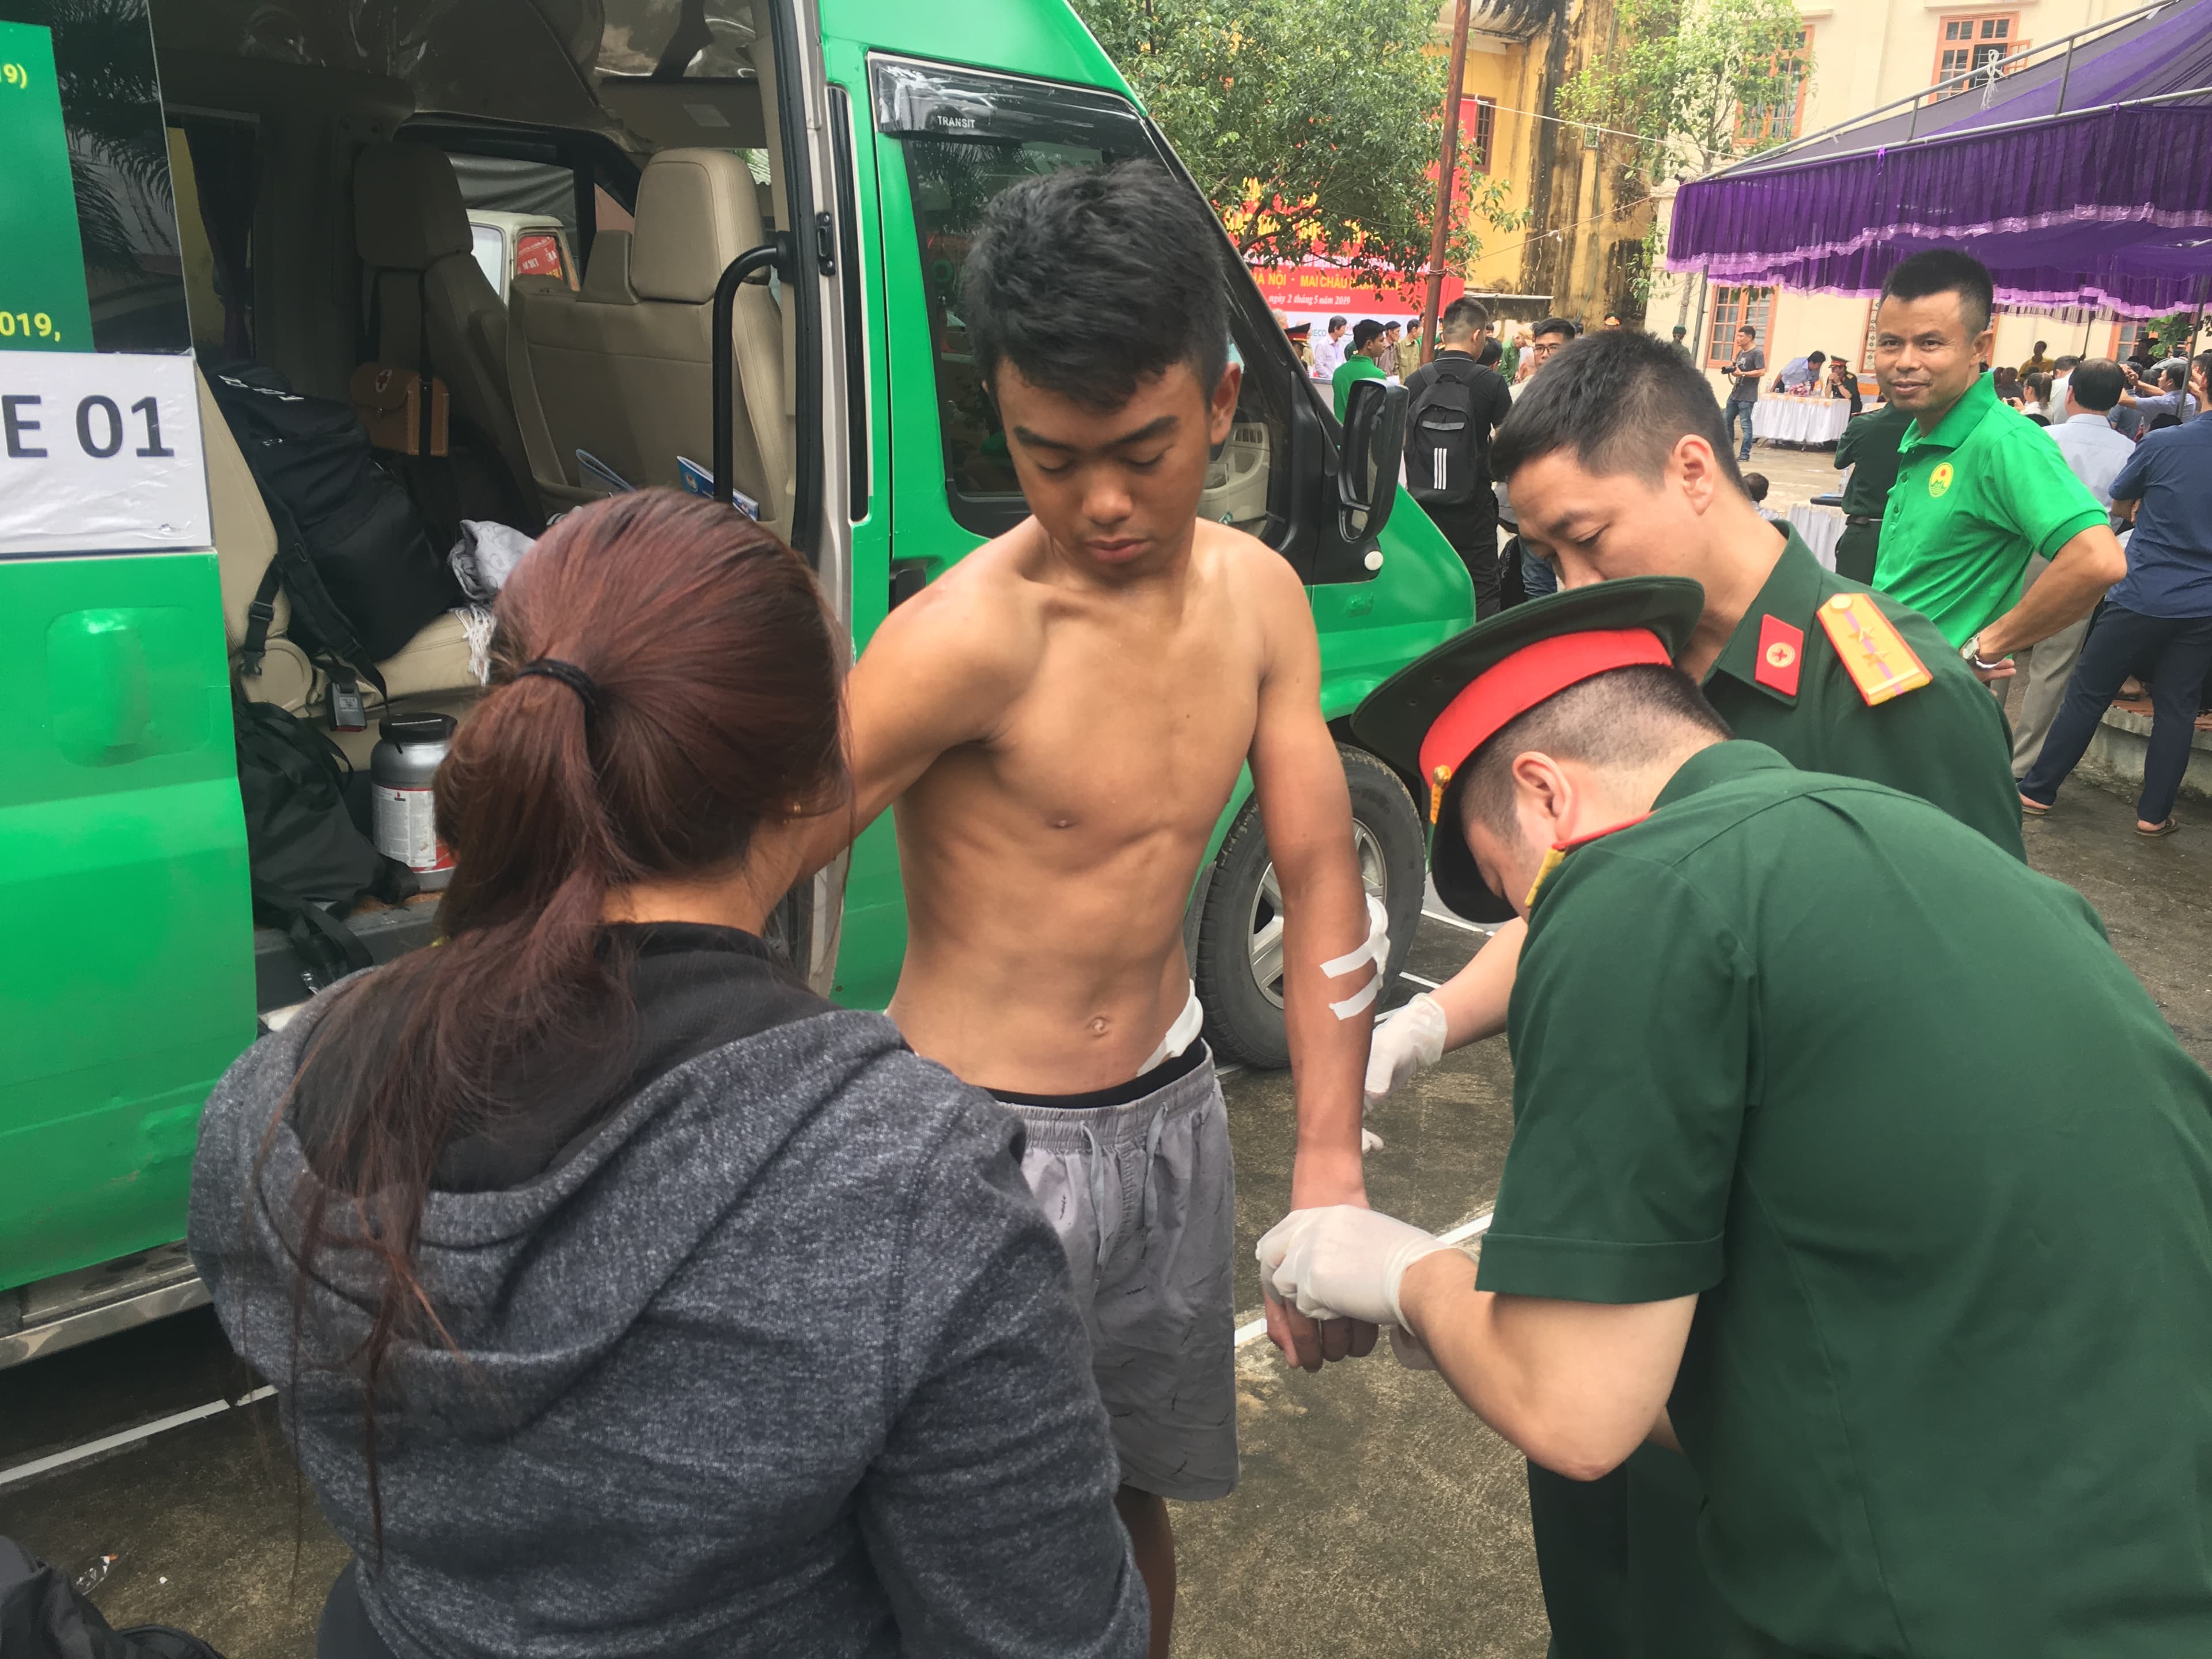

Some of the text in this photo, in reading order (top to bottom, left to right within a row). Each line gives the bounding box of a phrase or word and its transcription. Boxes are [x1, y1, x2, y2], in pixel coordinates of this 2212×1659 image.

[0, 63, 27, 89] 9)
[937, 115, 976, 129] TRANSIT
[1268, 269, 1286, 289] NỘI
[1300, 275, 1318, 287] MAI
[1320, 273, 1347, 289] CHÂU
[1268, 293, 1351, 305] ngày 2 tháng 5 năm 2019
[1, 395, 175, 459] E 01
